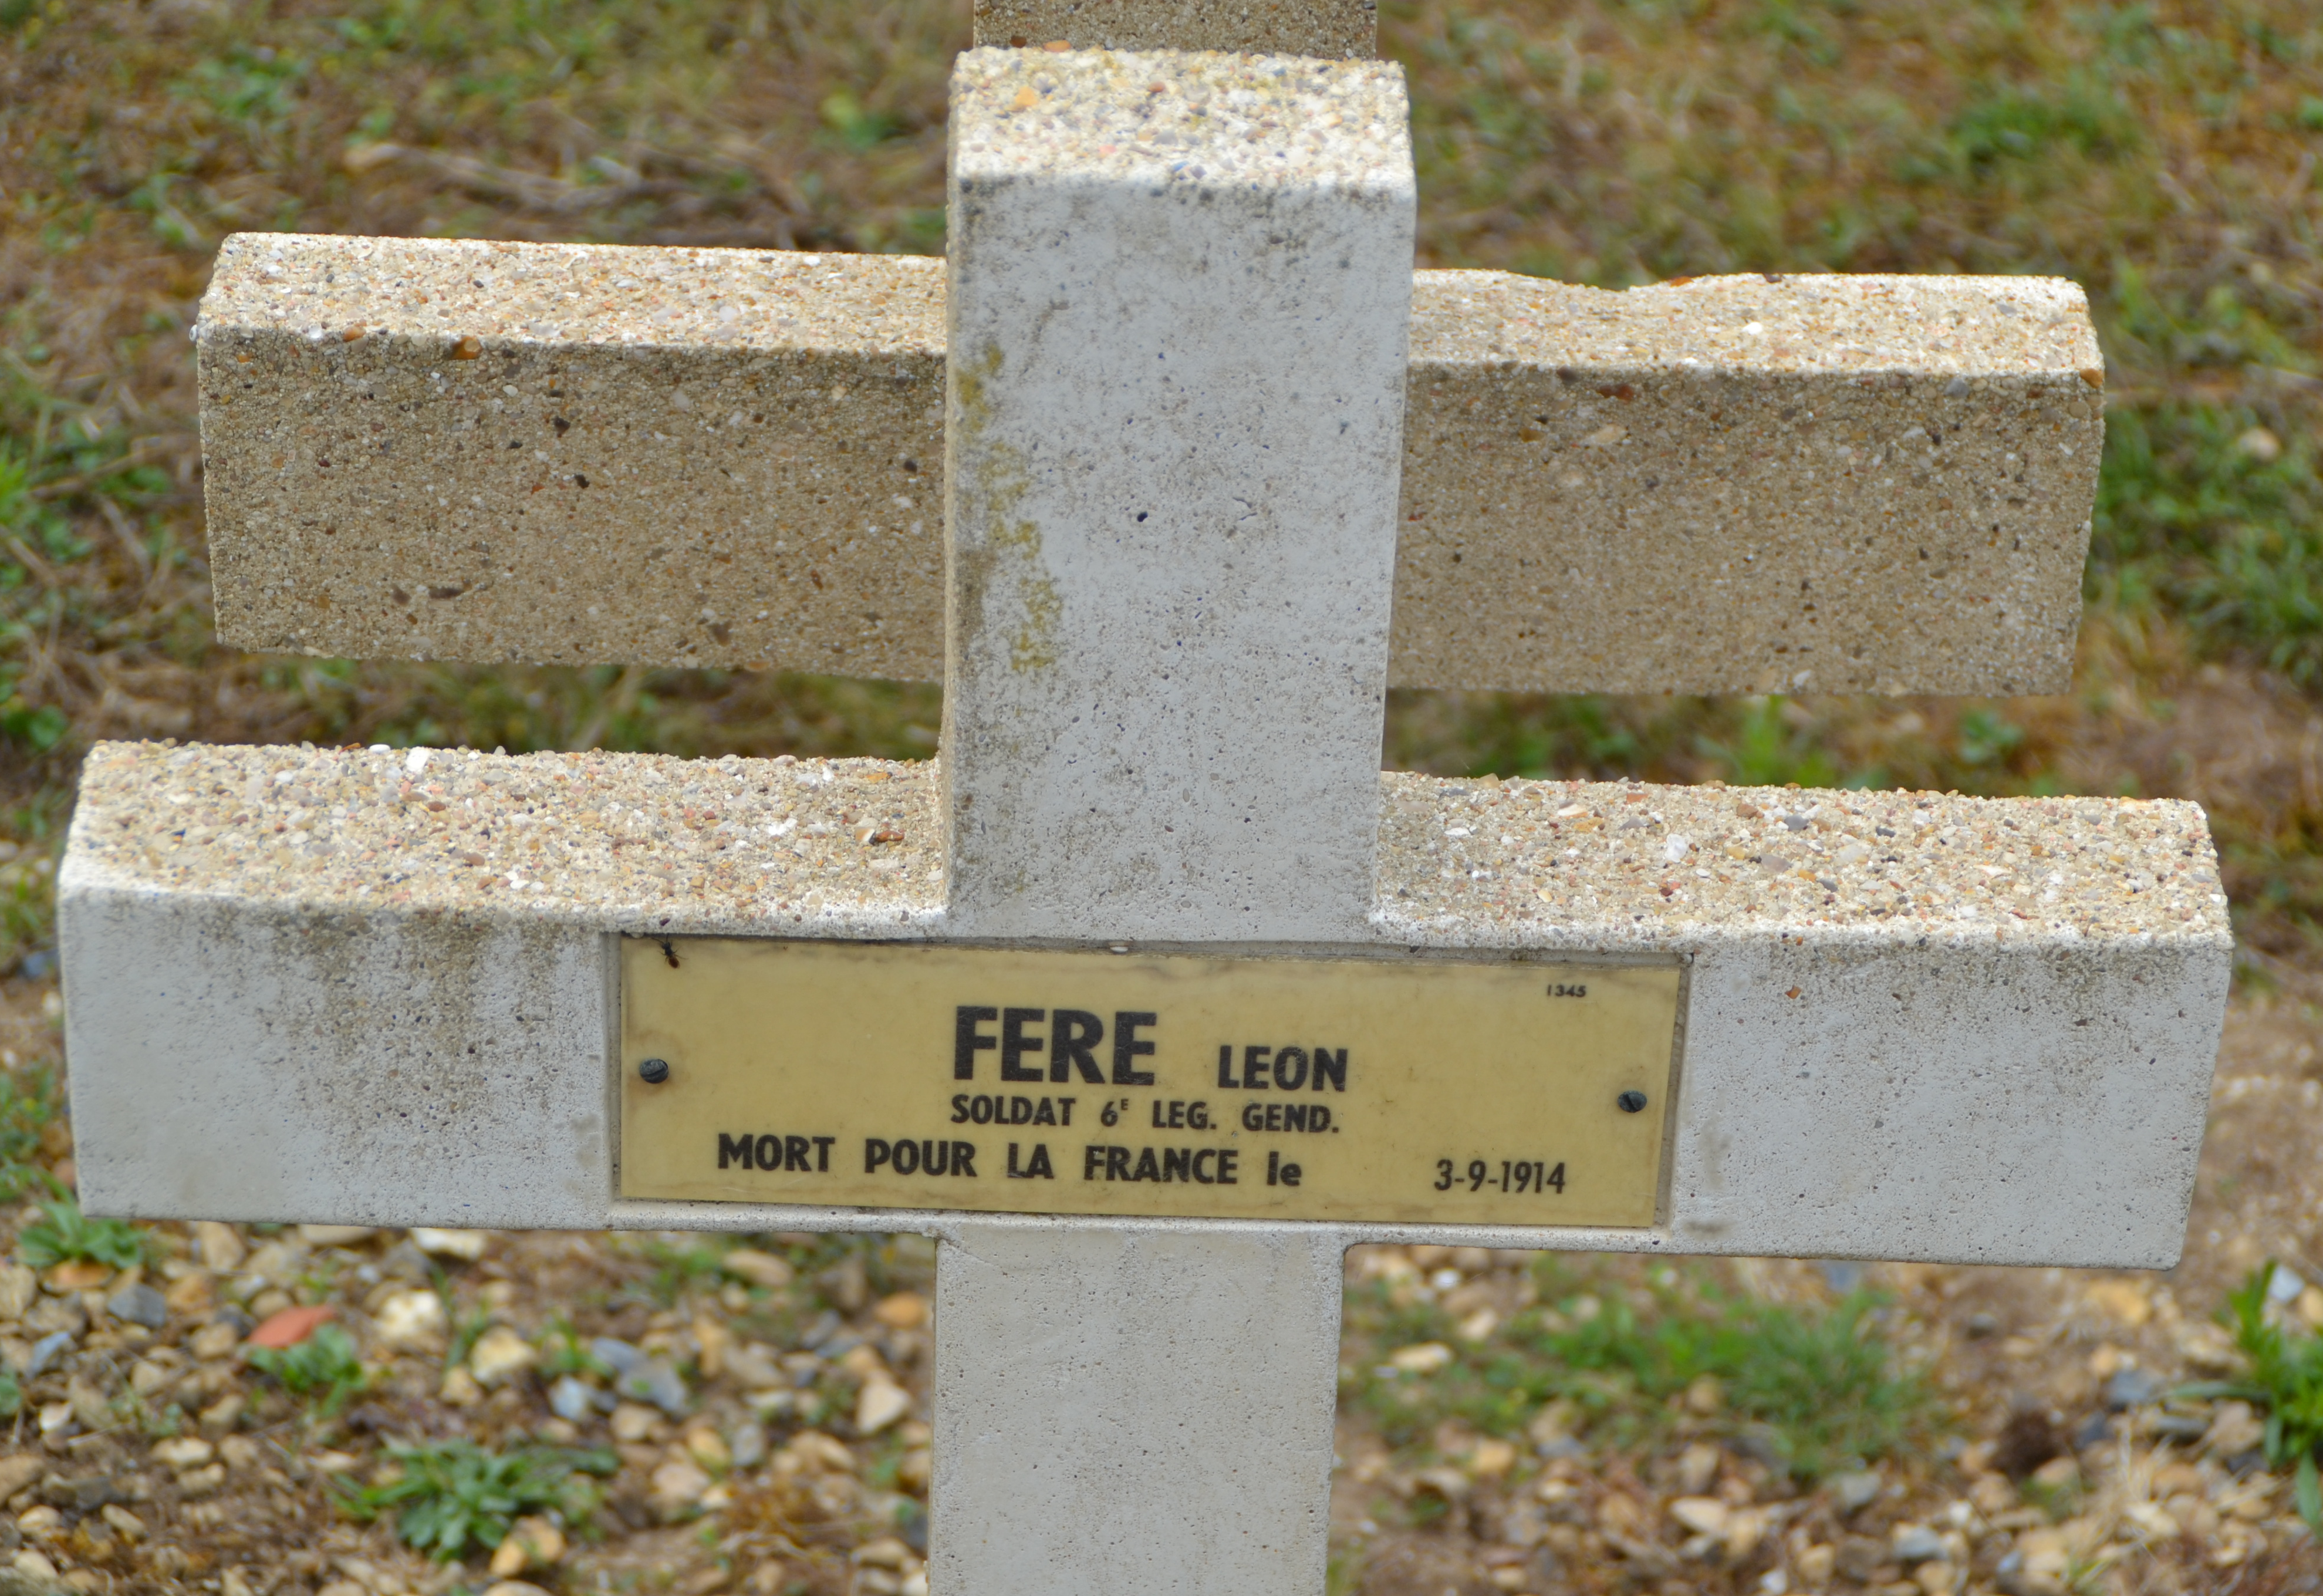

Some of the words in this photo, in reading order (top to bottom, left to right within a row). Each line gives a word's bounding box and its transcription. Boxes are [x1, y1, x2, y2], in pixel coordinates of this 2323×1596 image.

[1546, 983, 1588, 999] 1345
[953, 1004, 1159, 1088] FERE
[1216, 1043, 1349, 1094] LEON
[949, 1094, 1076, 1127] SOLDAT
[1150, 1099, 1218, 1133] LEG.
[1240, 1099, 1341, 1135] GEND.
[716, 1131, 837, 1174] MORT
[863, 1136, 979, 1179] POUR
[1005, 1141, 1056, 1181] LA
[1082, 1143, 1240, 1186] FRANCE
[1265, 1149, 1304, 1189] le
[1433, 1156, 1567, 1195] 3-9-1914
